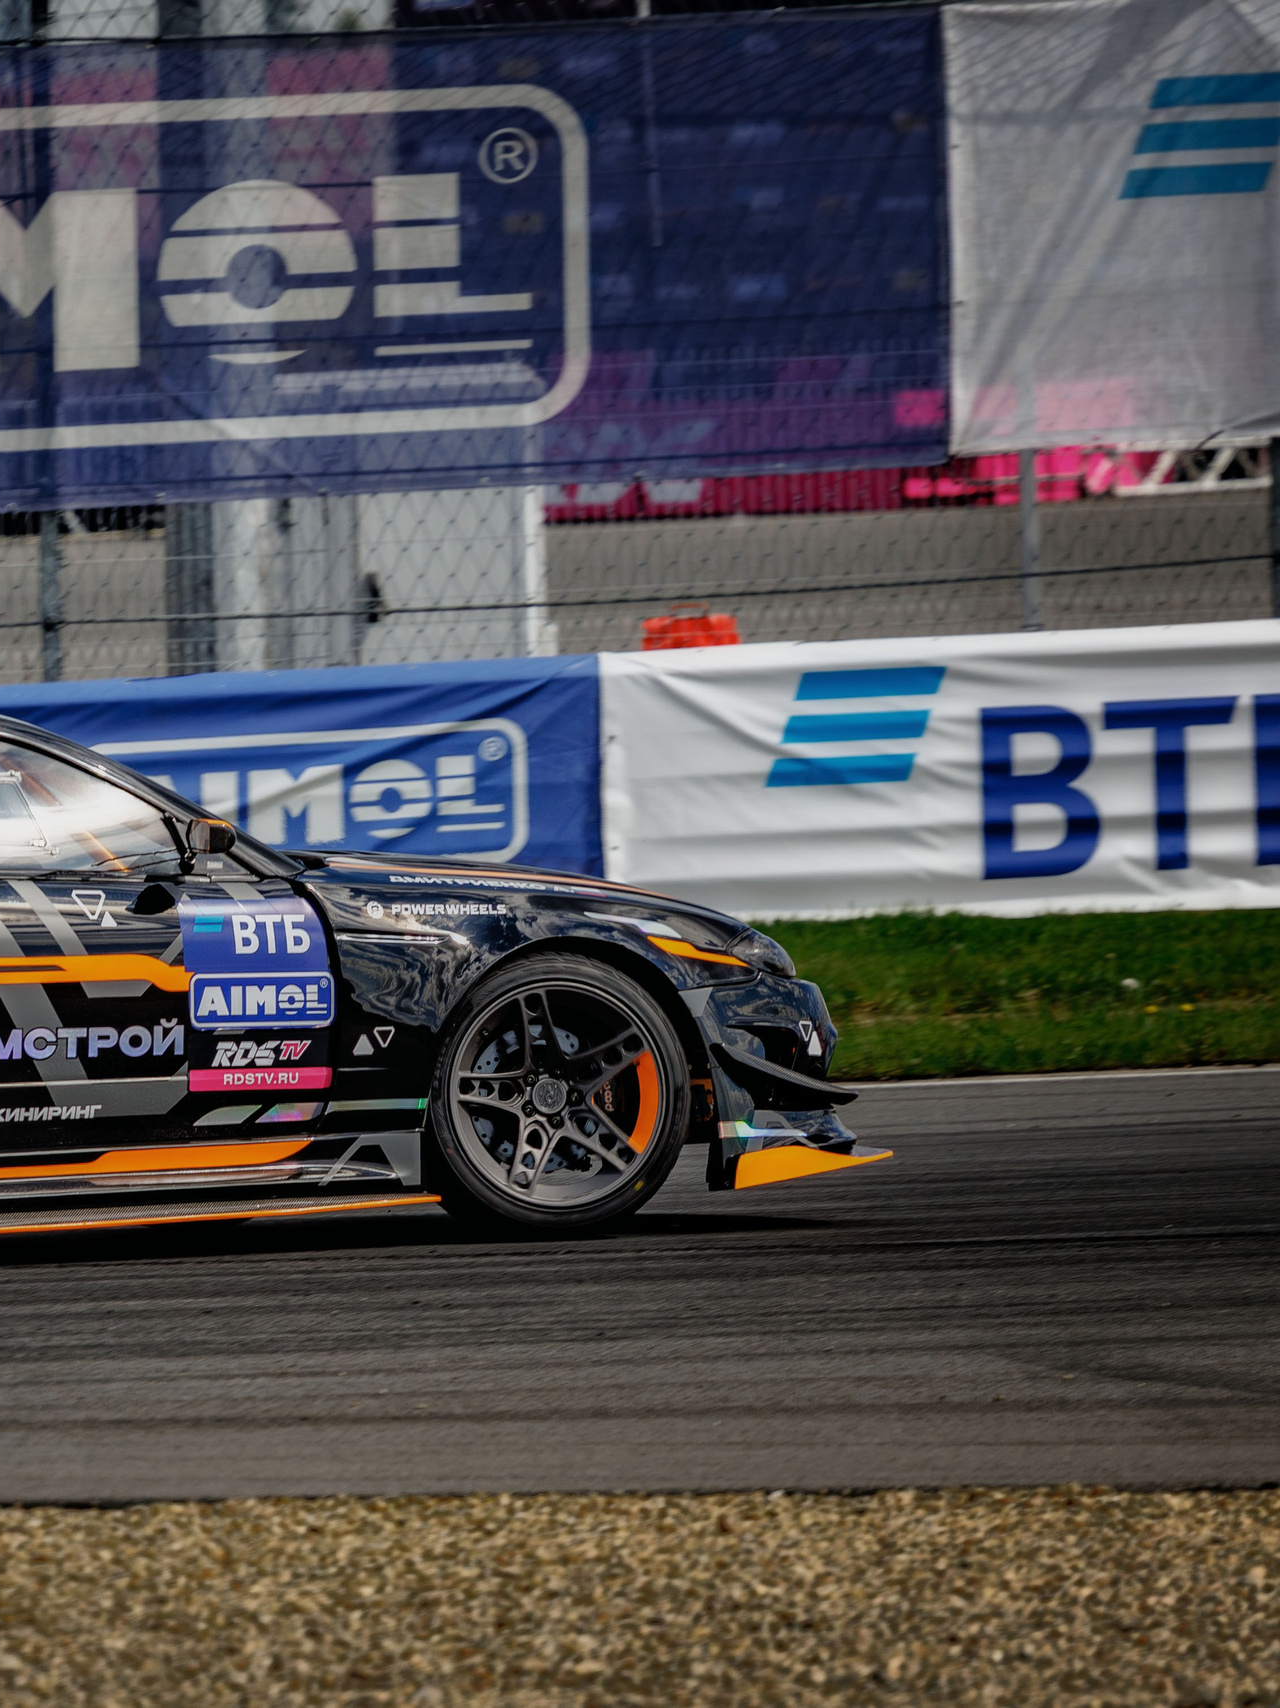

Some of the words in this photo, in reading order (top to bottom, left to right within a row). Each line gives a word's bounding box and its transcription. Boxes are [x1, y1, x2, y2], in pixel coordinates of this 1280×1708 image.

[146, 758, 506, 846] IMOL
[980, 693, 1280, 880] ВТ
[391, 903, 507, 916] POWERWHEELS
[231, 914, 311, 955] ВТБ
[223, 1072, 299, 1086] RDSTV.RU
